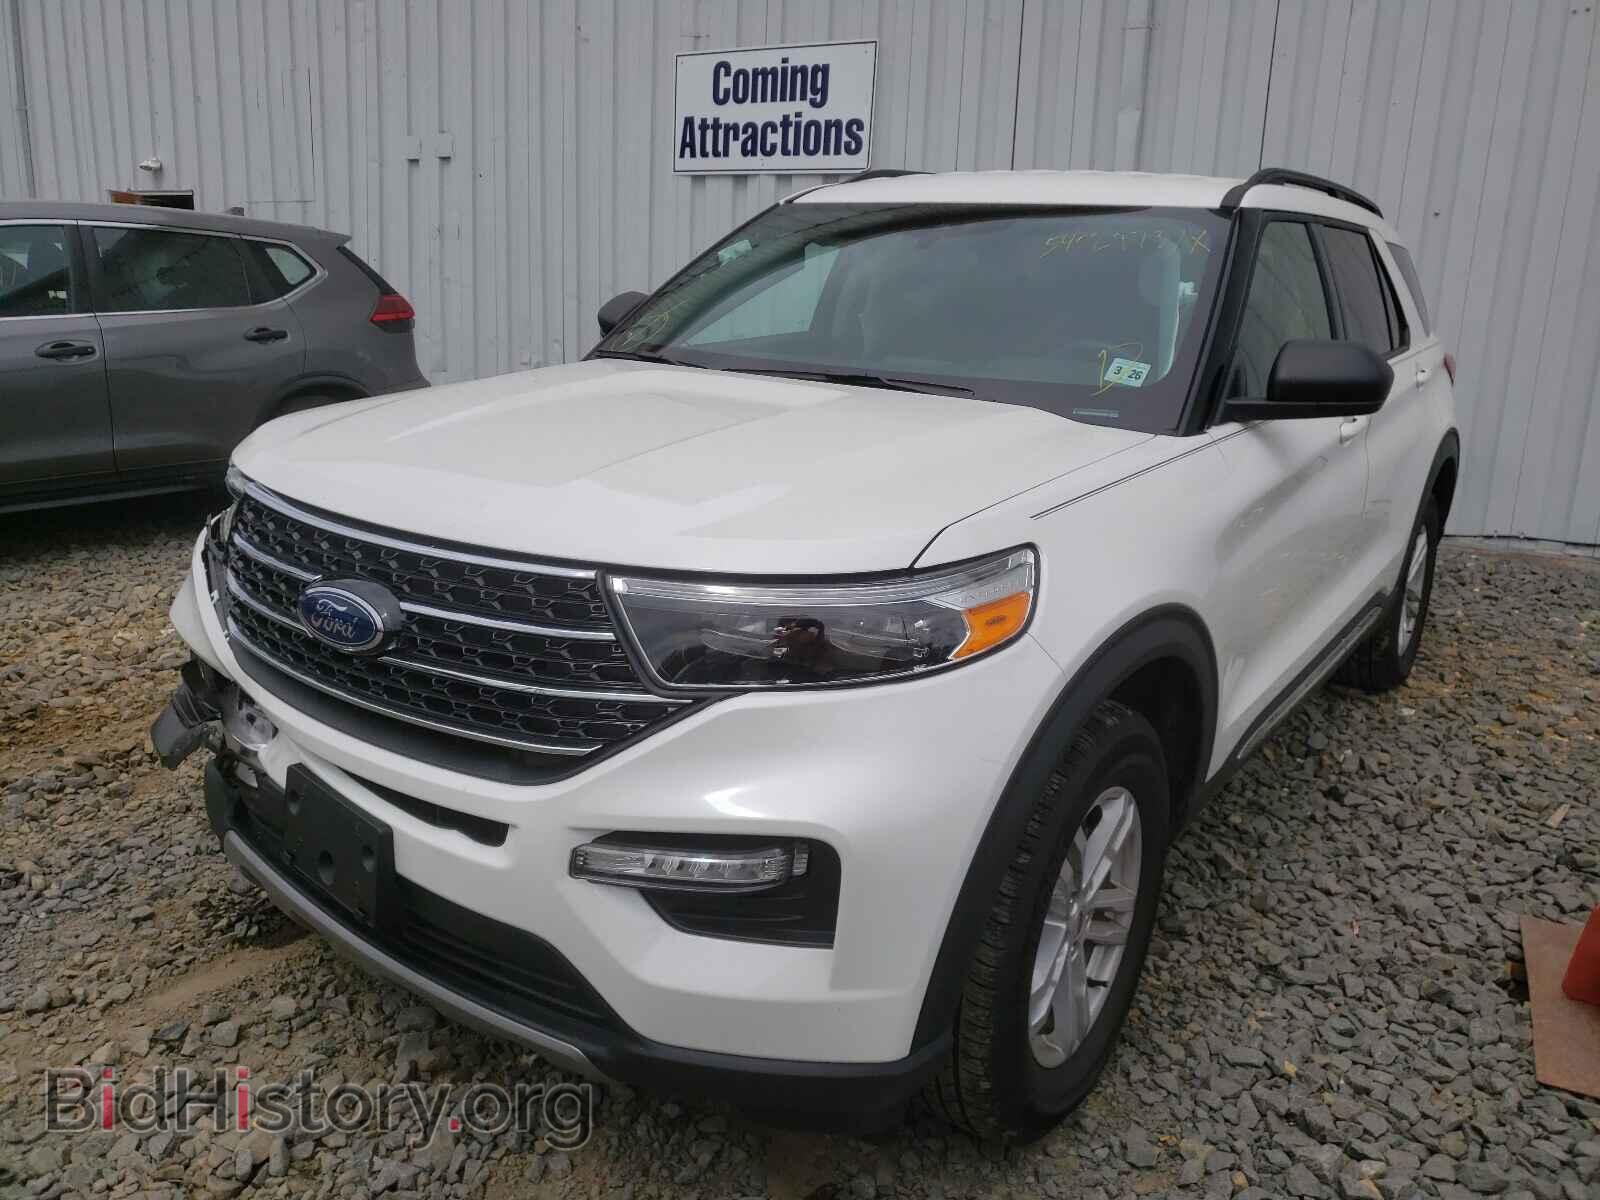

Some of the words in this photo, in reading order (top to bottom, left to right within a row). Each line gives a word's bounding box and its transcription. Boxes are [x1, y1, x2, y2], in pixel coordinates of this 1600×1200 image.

[712, 57, 830, 108] Coming
[679, 112, 865, 158] Attractions
[1113, 365, 1123, 375] 3
[1127, 369, 1144, 380] 26
[311, 599, 360, 639] Ford
